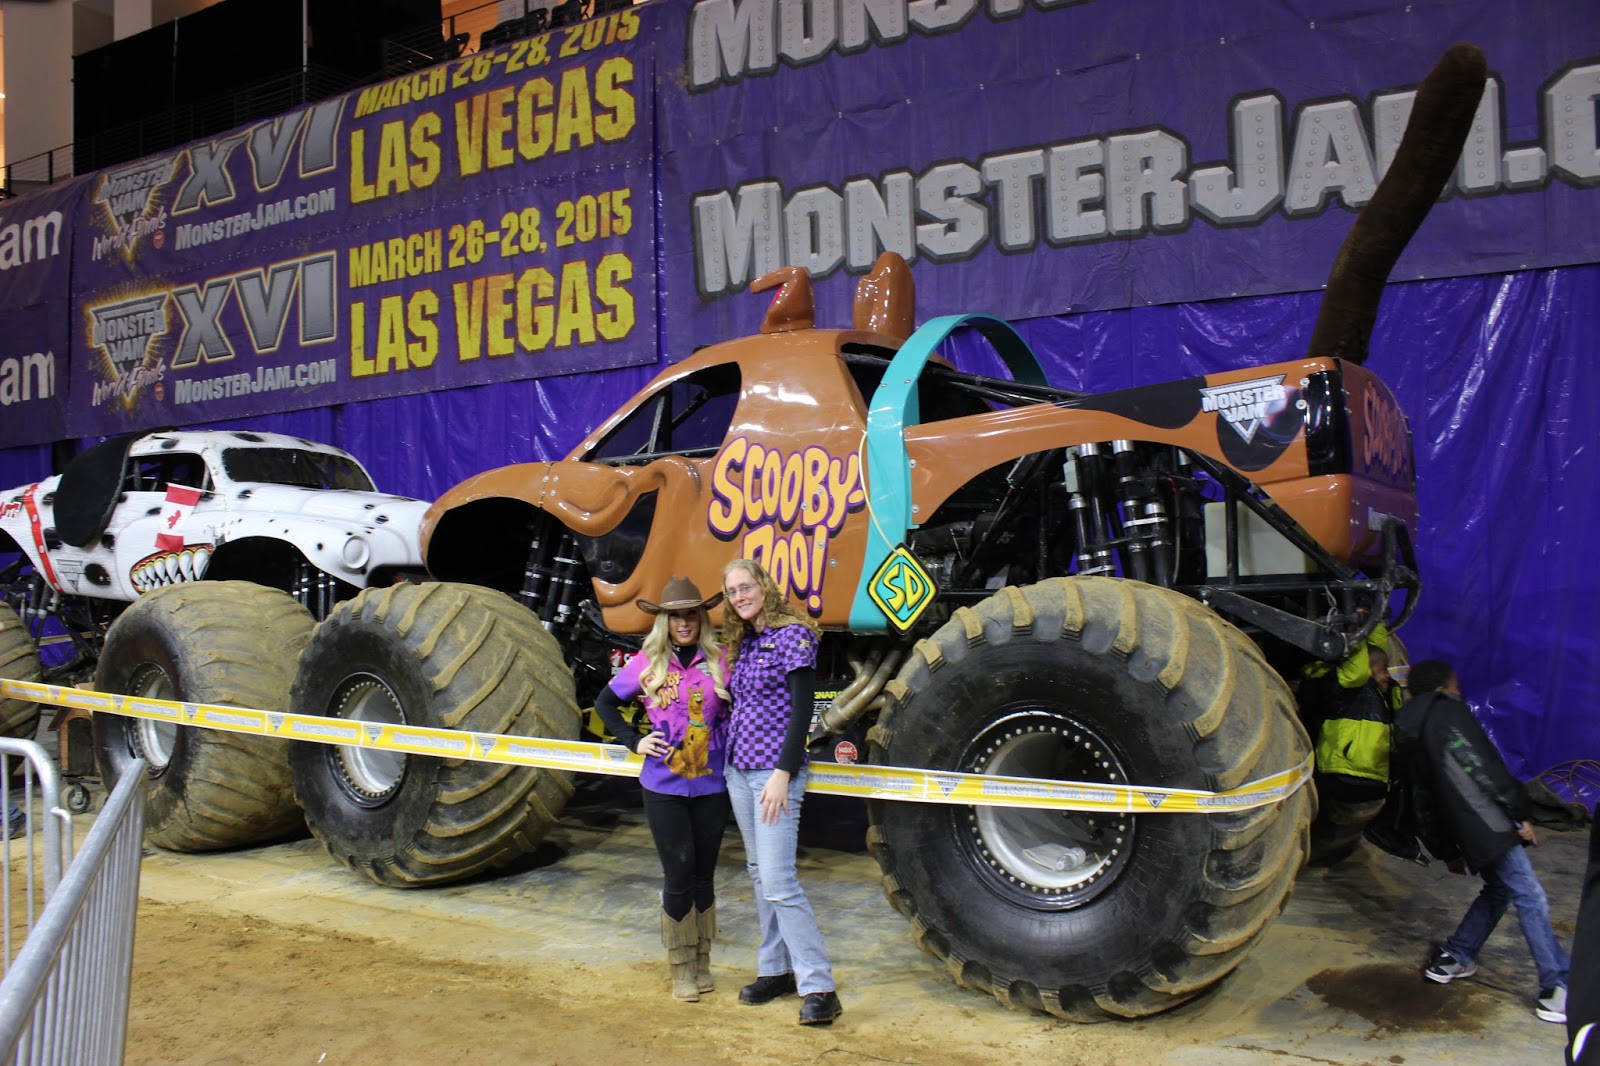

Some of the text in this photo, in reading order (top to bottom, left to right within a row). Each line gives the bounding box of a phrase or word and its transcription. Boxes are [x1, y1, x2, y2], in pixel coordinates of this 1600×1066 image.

[354, 6, 642, 119] MARCH 26-28, 2015
[690, 0, 1090, 88] MON
[173, 98, 344, 215] XVI
[350, 56, 636, 204] LAS VEGAS
[0, 210, 63, 270] am
[349, 188, 632, 288] MARCH 26-28, 2015
[94, 309, 166, 345] MONSTER
[109, 336, 148, 364] JAM
[173, 251, 337, 368] XVI
[350, 253, 636, 377] LAS VEGAS
[1202, 385, 1286, 413] MONSTER
[1212, 403, 1267, 423] JAM
[708, 437, 865, 533] SCOOBY-
[882, 561, 925, 614] SD
